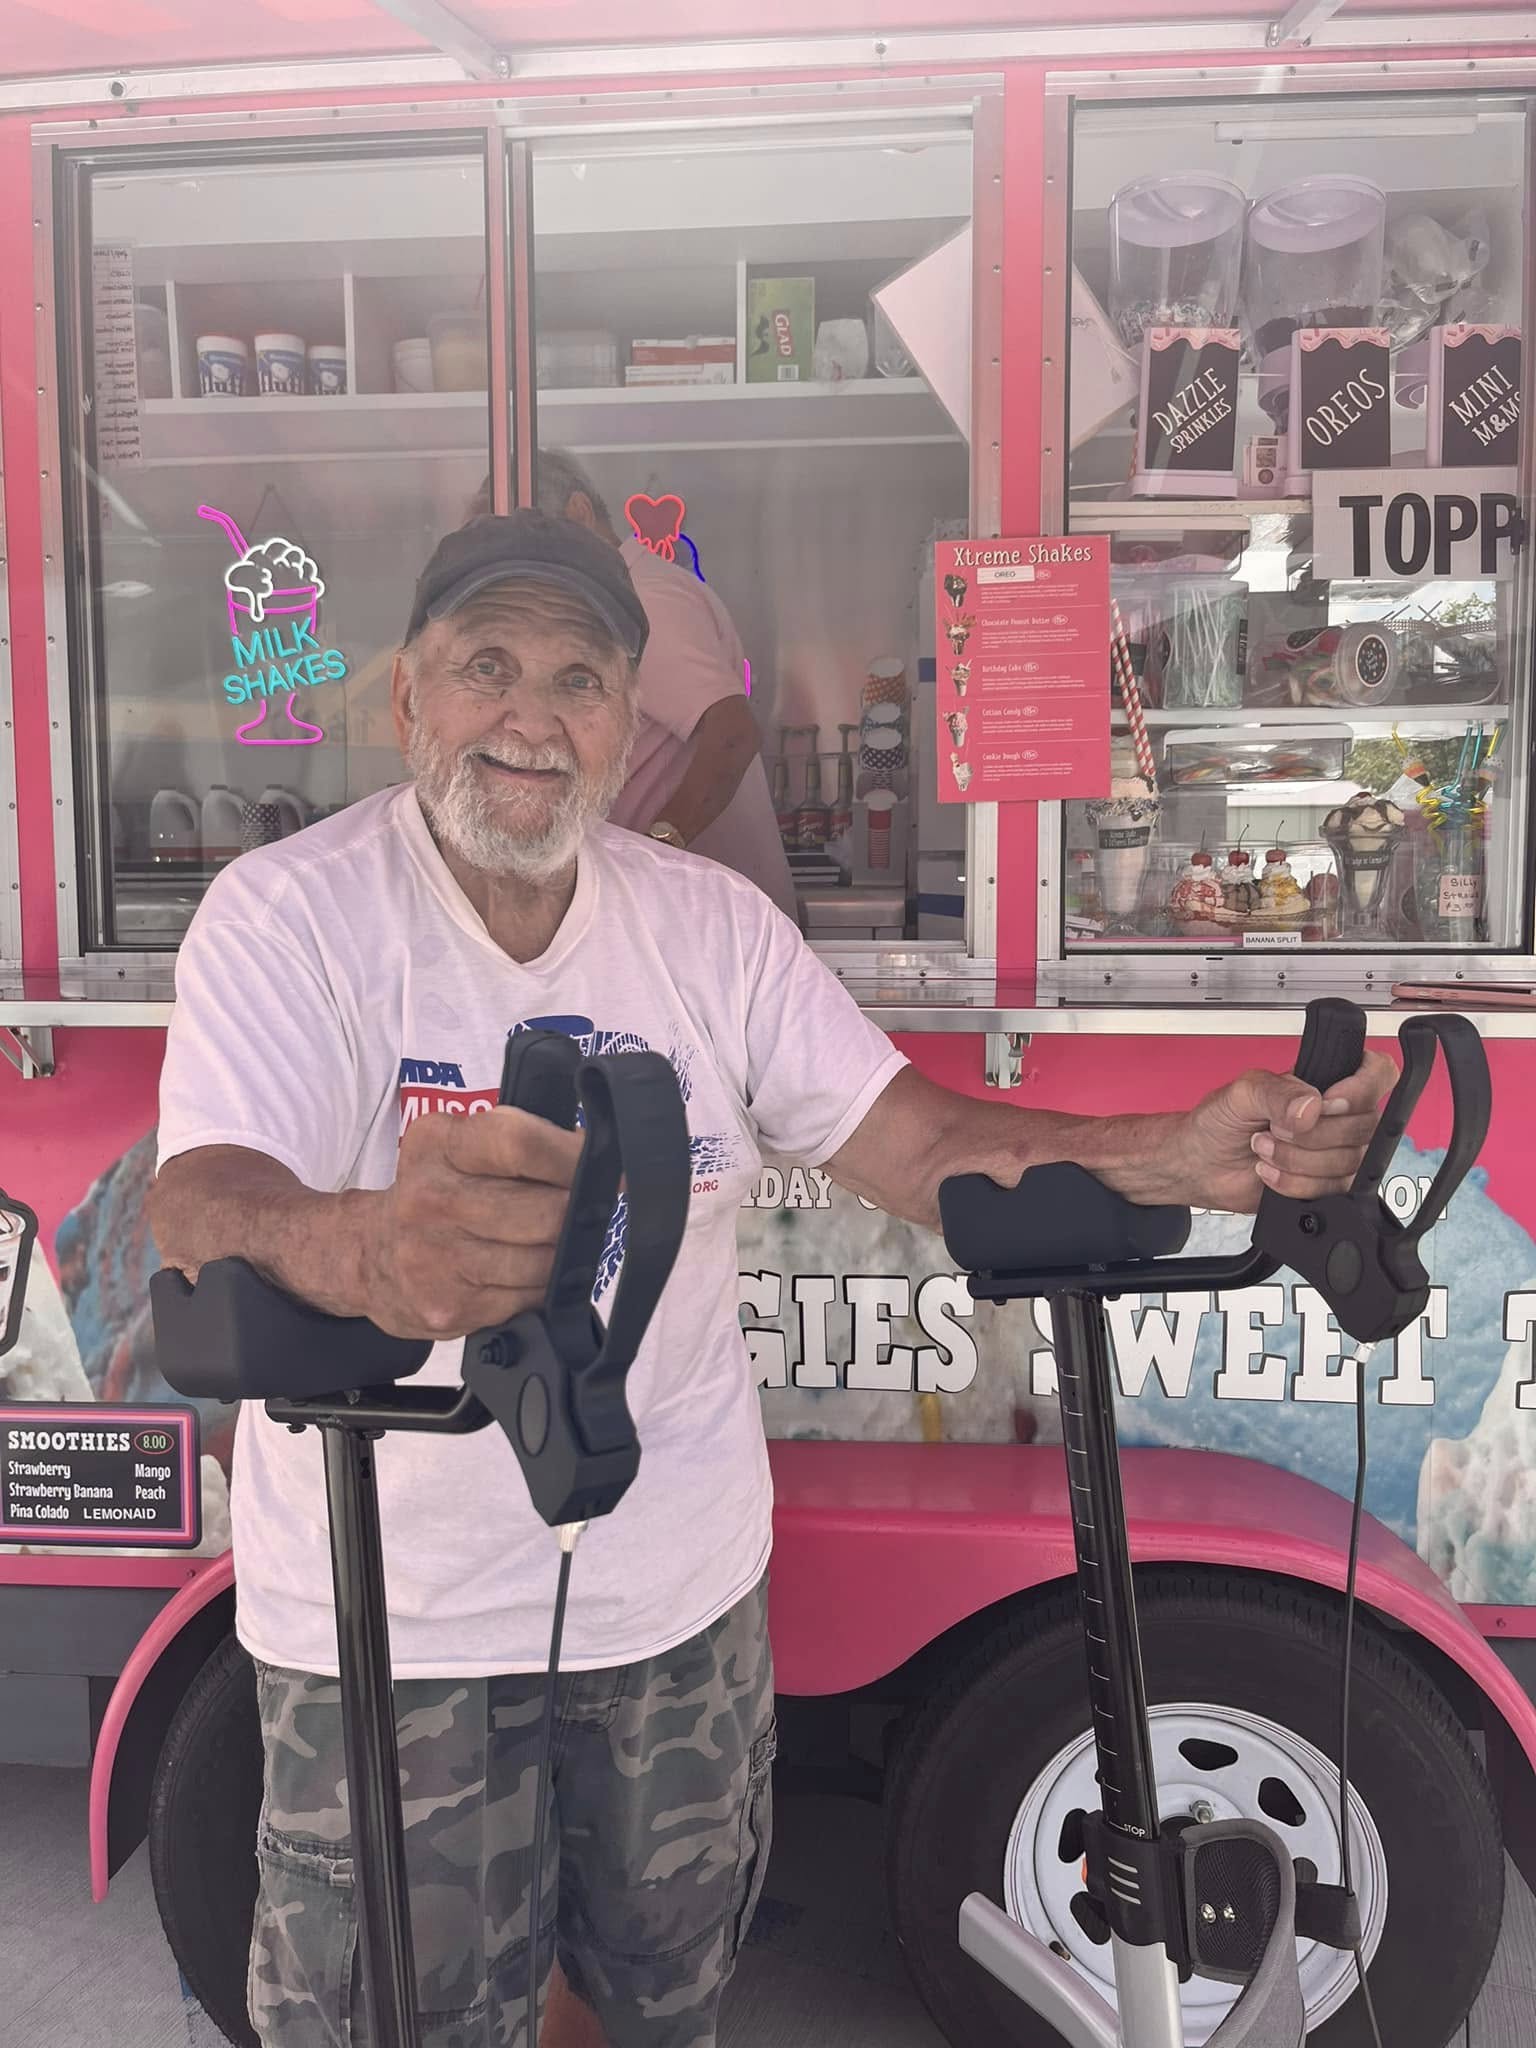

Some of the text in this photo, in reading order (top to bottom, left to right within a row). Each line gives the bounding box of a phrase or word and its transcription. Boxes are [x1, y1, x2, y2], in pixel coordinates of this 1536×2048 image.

[775, 313, 792, 356] GLAD
[1152, 367, 1227, 436] DAZZLE
[1306, 368, 1386, 447] OREOS
[1448, 364, 1513, 427] MINI
[1169, 397, 1233, 454] SPRINKLES
[953, 542, 1093, 567] Xtreme Shakes
[994, 570, 1016, 579] OREO
[231, 616, 321, 670] MILK
[223, 649, 347, 705] SHAKES
[982, 664, 1007, 674] Birthday
[1245, 936, 1276, 944] BANANA
[740, 1165, 833, 1210] DAY
[1029, 1282, 1449, 1405] WEET
[8, 1430, 167, 1452] SMOOTHIES 8.00
[8, 1460, 171, 1481] Strawberry Mango
[9, 1481, 166, 1501] Strawberry Banana Peach
[10, 1503, 157, 1520] Pina Colado LEMONAID
[1123, 1823, 1146, 1838] STOP
